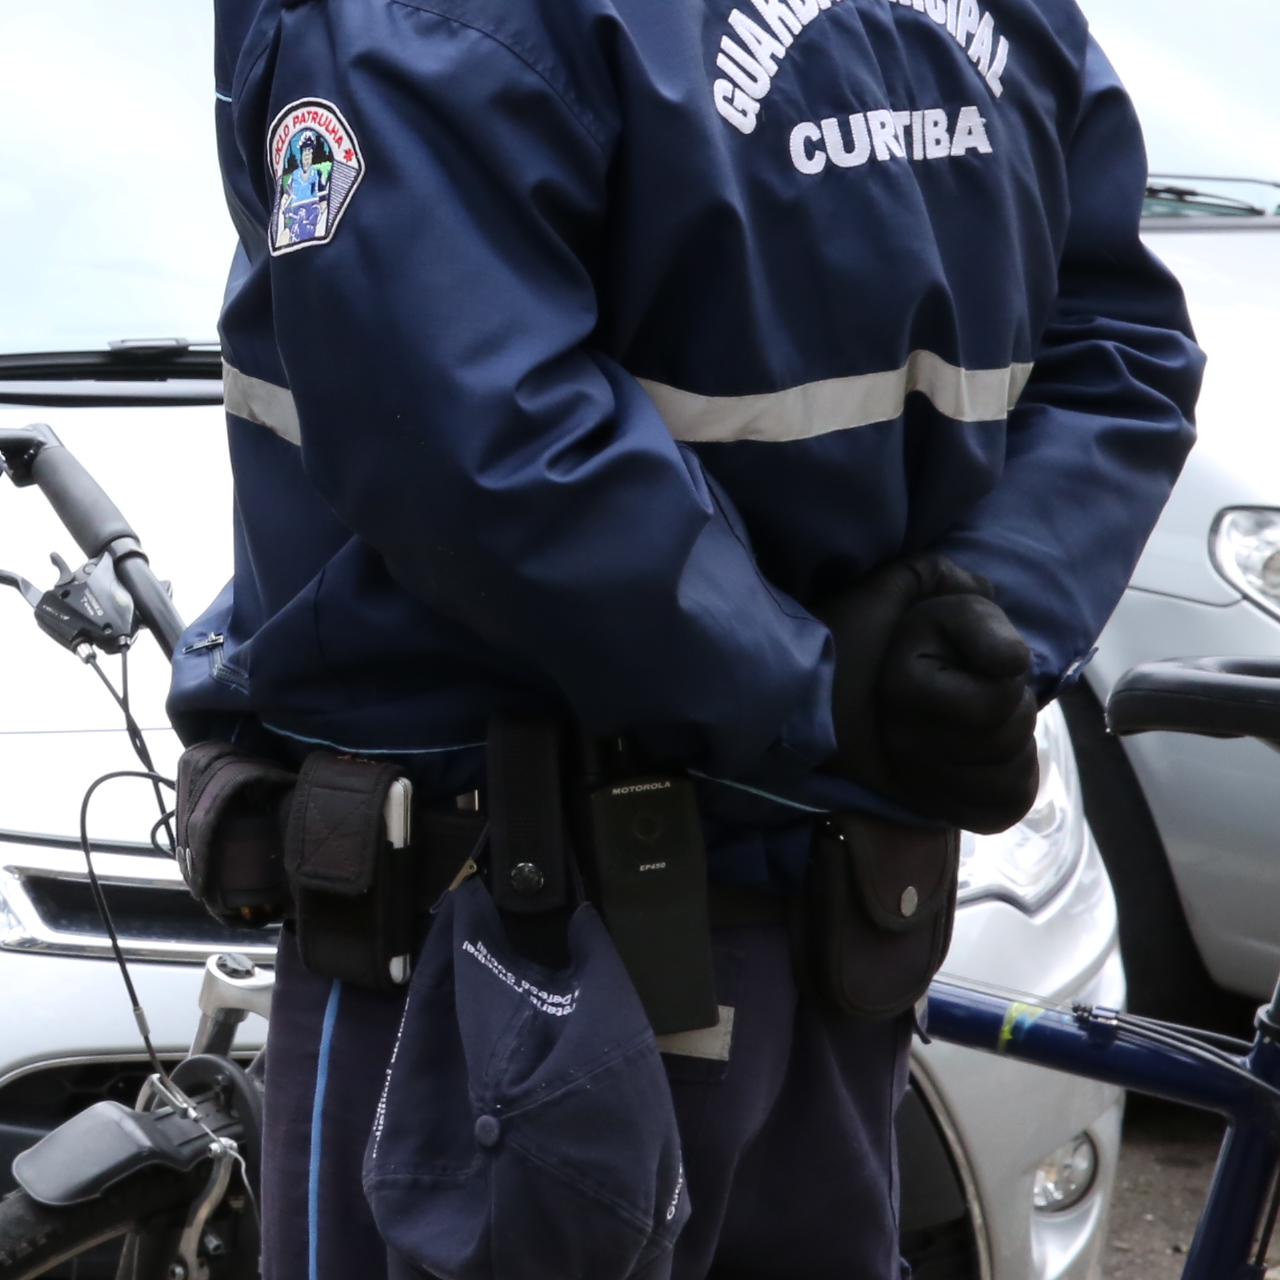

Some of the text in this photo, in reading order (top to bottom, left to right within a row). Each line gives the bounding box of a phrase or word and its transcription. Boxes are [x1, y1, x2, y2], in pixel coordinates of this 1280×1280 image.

[292, 110, 344, 150] PATRULHA
[789, 106, 993, 175] CURTIBA
[611, 781, 671, 795] MOTOROLA
[639, 862, 666, 871] EP450
